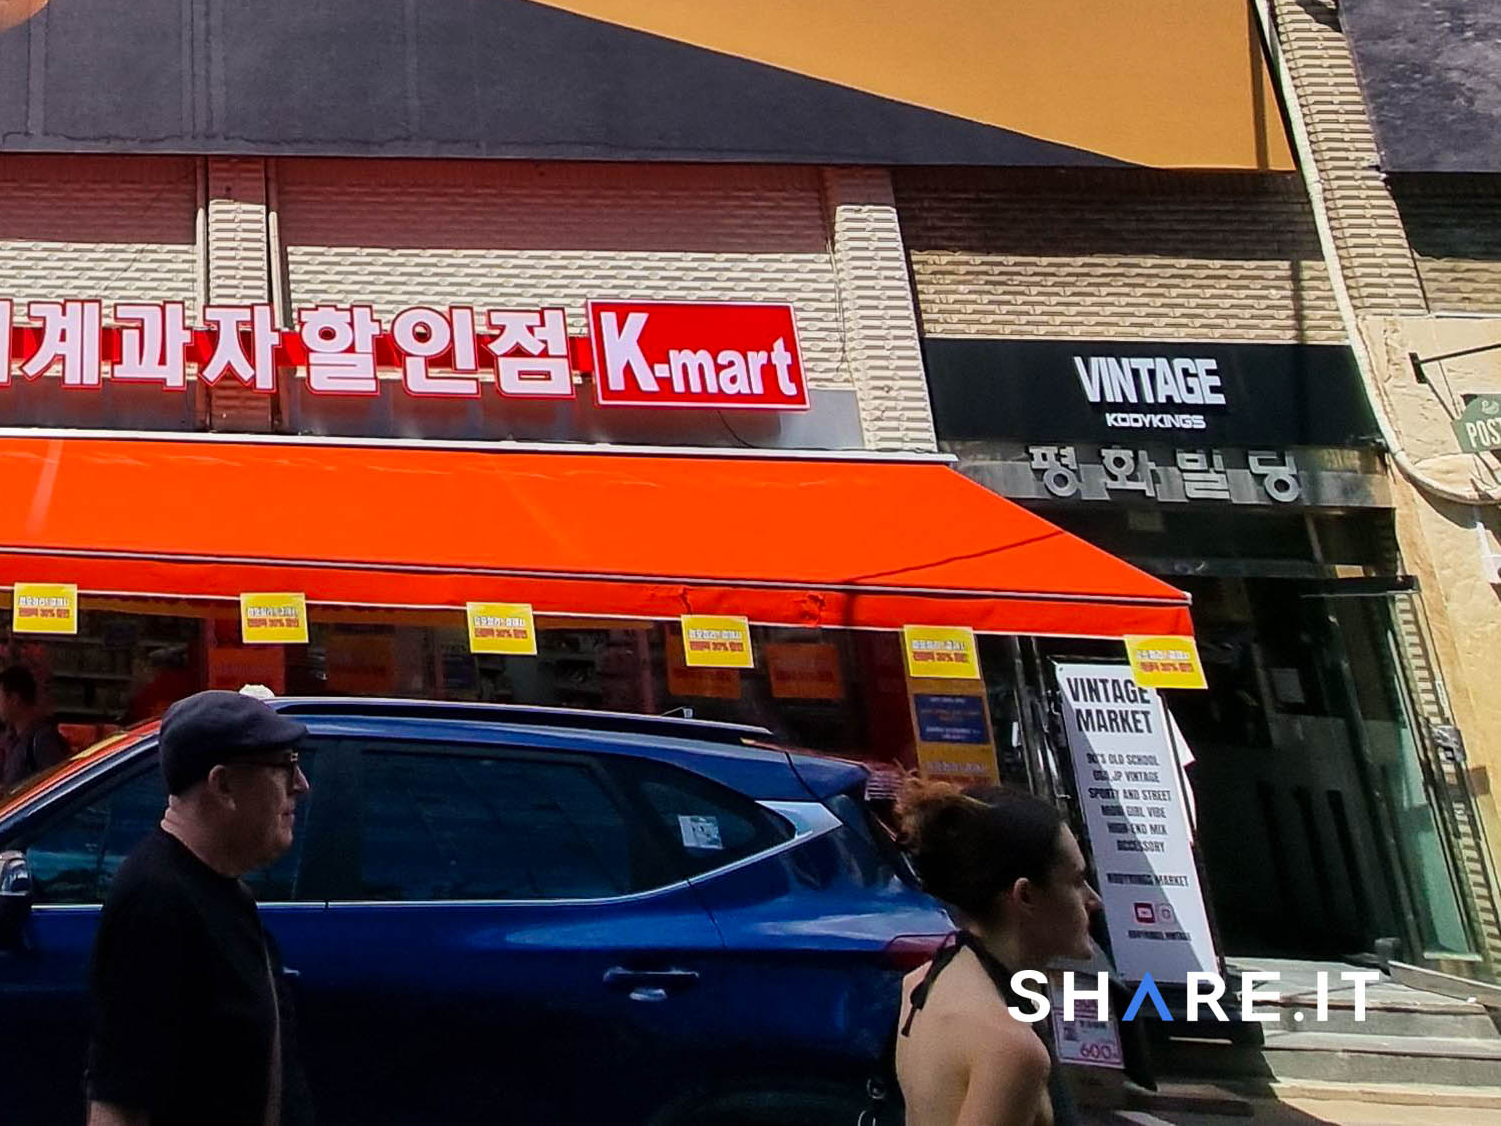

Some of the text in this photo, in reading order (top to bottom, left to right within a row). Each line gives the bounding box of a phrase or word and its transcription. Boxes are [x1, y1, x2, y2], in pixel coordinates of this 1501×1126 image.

[600, 312, 797, 396] K-mart
[1073, 356, 1226, 405] VINTAGE
[1105, 413, 1207, 429] KODYKINGS
[1465, 417, 1501, 449] POS
[1029, 445, 1301, 504] 평화빌딩
[1066, 677, 1151, 704] VINTAGE
[1075, 709, 1152, 734] MARKET
[1108, 754, 1124, 765] OLD
[1126, 754, 1160, 766] SCHOOL
[1125, 771, 1160, 783] VINTAGE
[1122, 789, 1140, 800] AND
[1141, 790, 1171, 801] STREET
[1149, 825, 1168, 835] MIX
